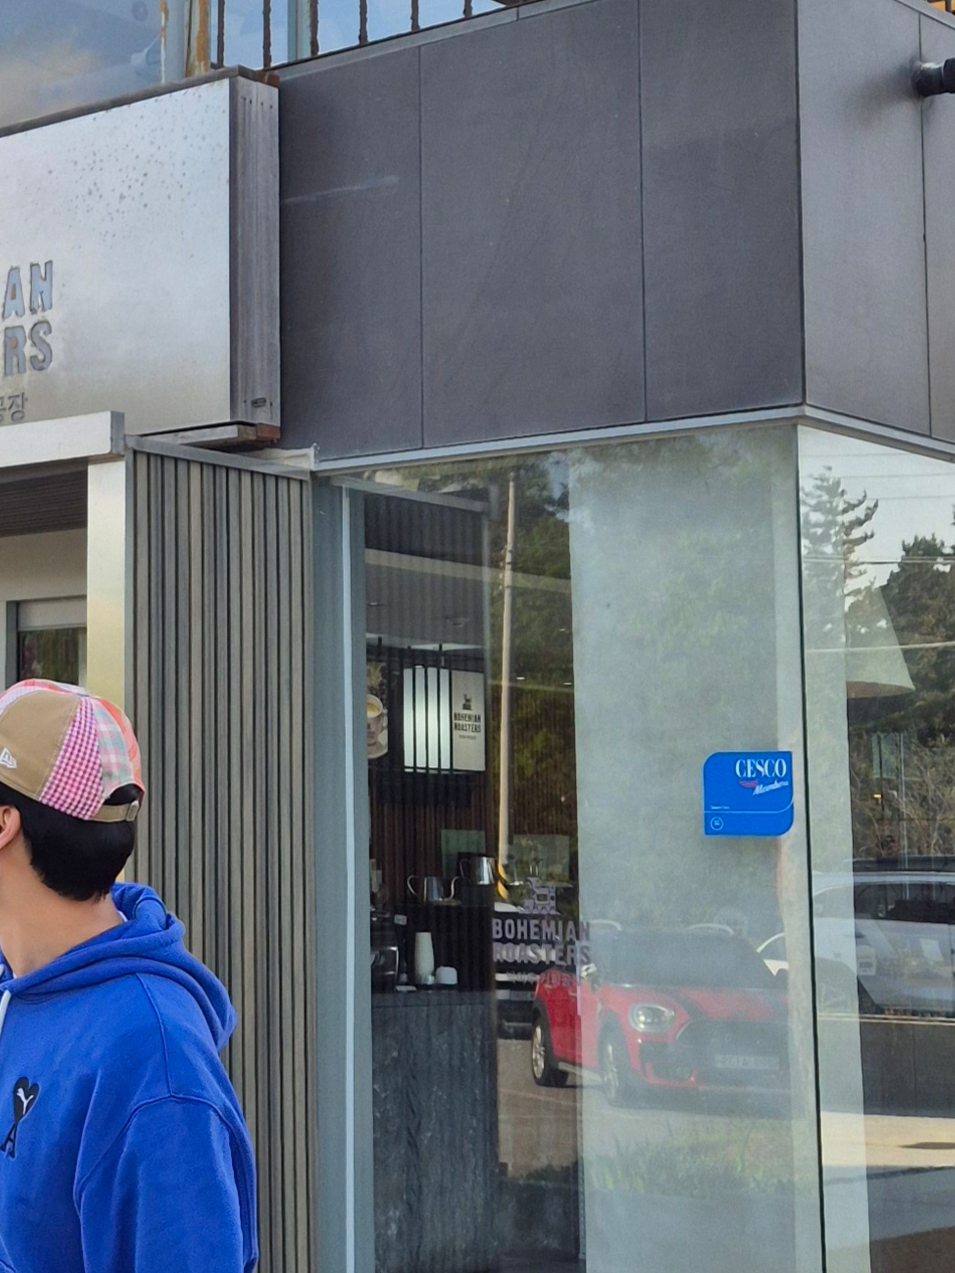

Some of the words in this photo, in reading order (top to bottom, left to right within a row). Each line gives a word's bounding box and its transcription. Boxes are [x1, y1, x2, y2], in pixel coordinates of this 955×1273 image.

[735, 758, 787, 778] CESCO
[492, 917, 591, 943] BOHEMIAN
[492, 941, 592, 966] ROASTERS
